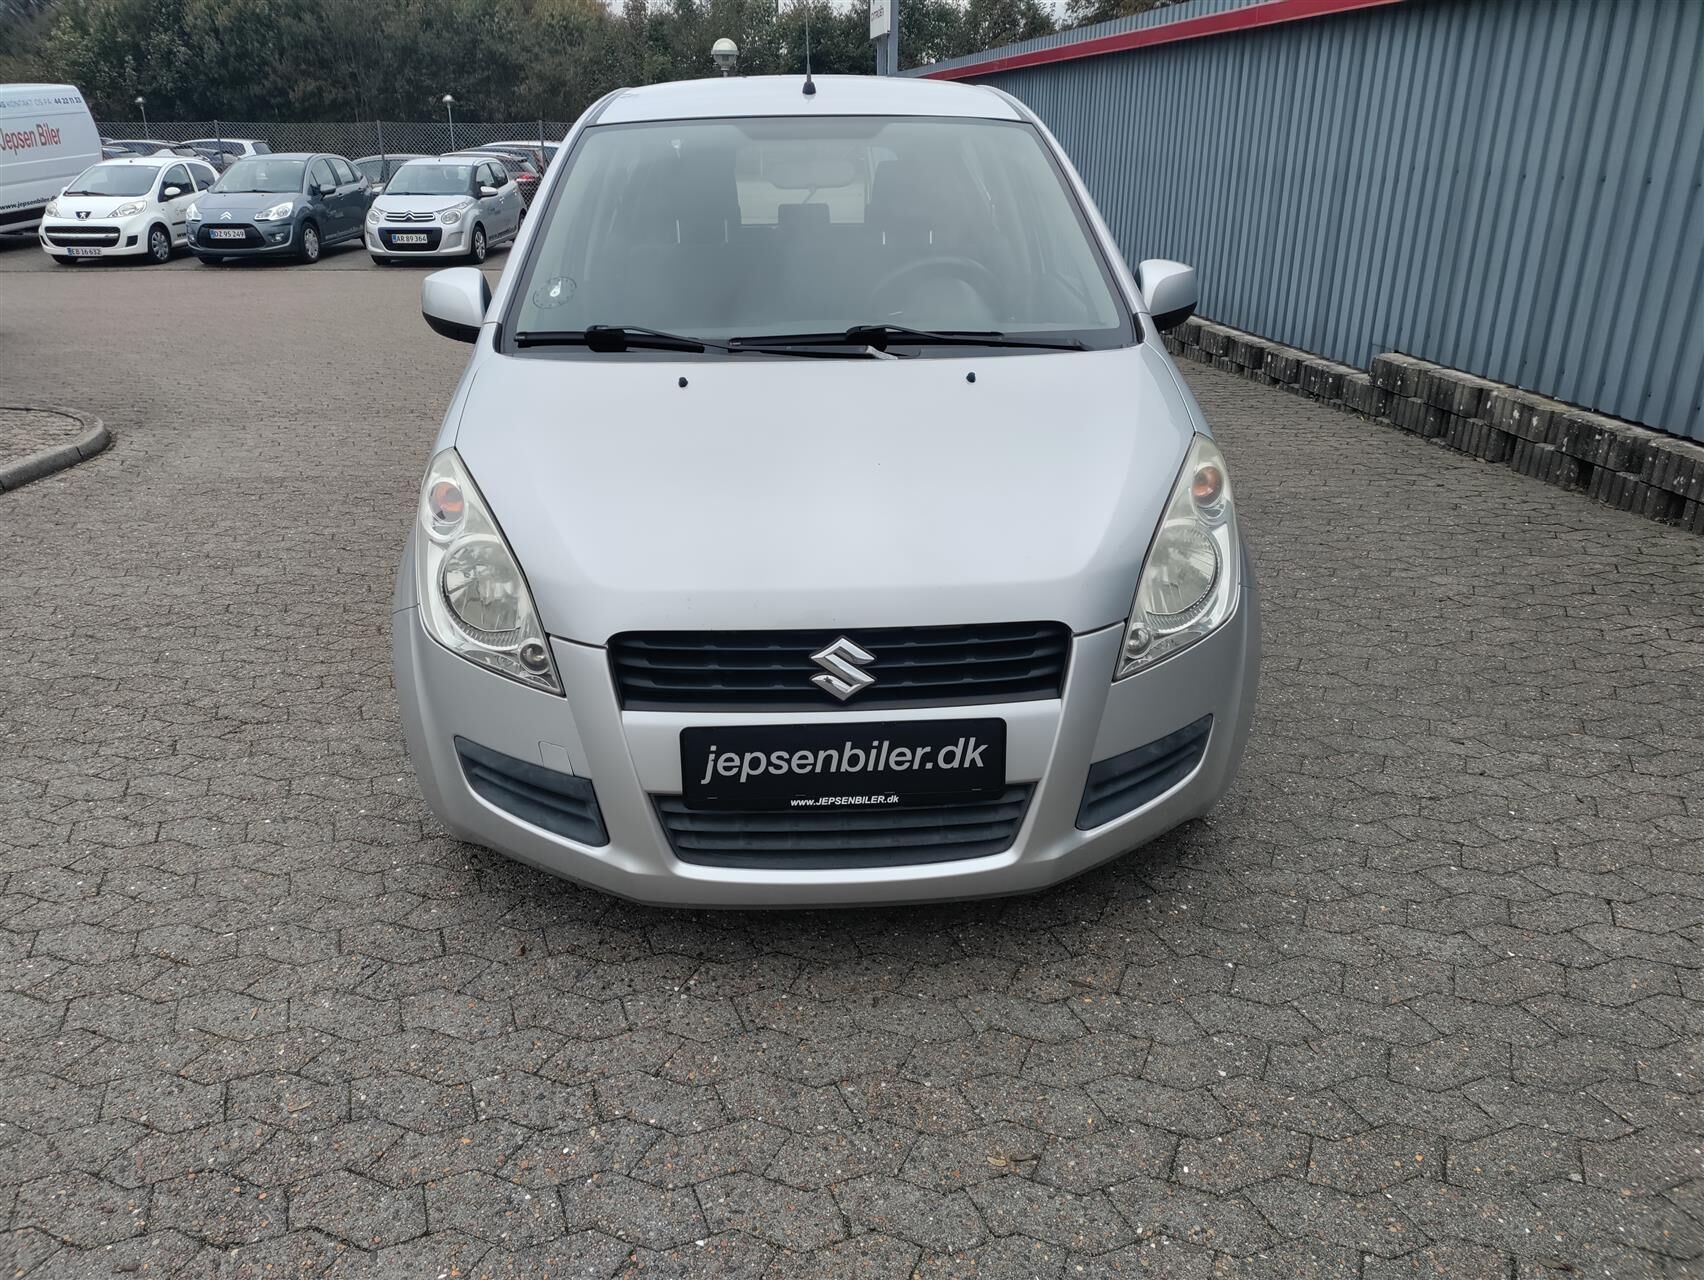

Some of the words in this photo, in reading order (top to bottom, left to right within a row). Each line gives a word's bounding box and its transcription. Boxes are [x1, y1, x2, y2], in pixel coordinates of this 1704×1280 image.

[0, 127, 37, 155] Jepsen
[36, 122, 61, 146] Biler
[701, 736, 988, 785] jepsenbiler.dk
[790, 795, 899, 806] www.JEPSENBILER.dk
